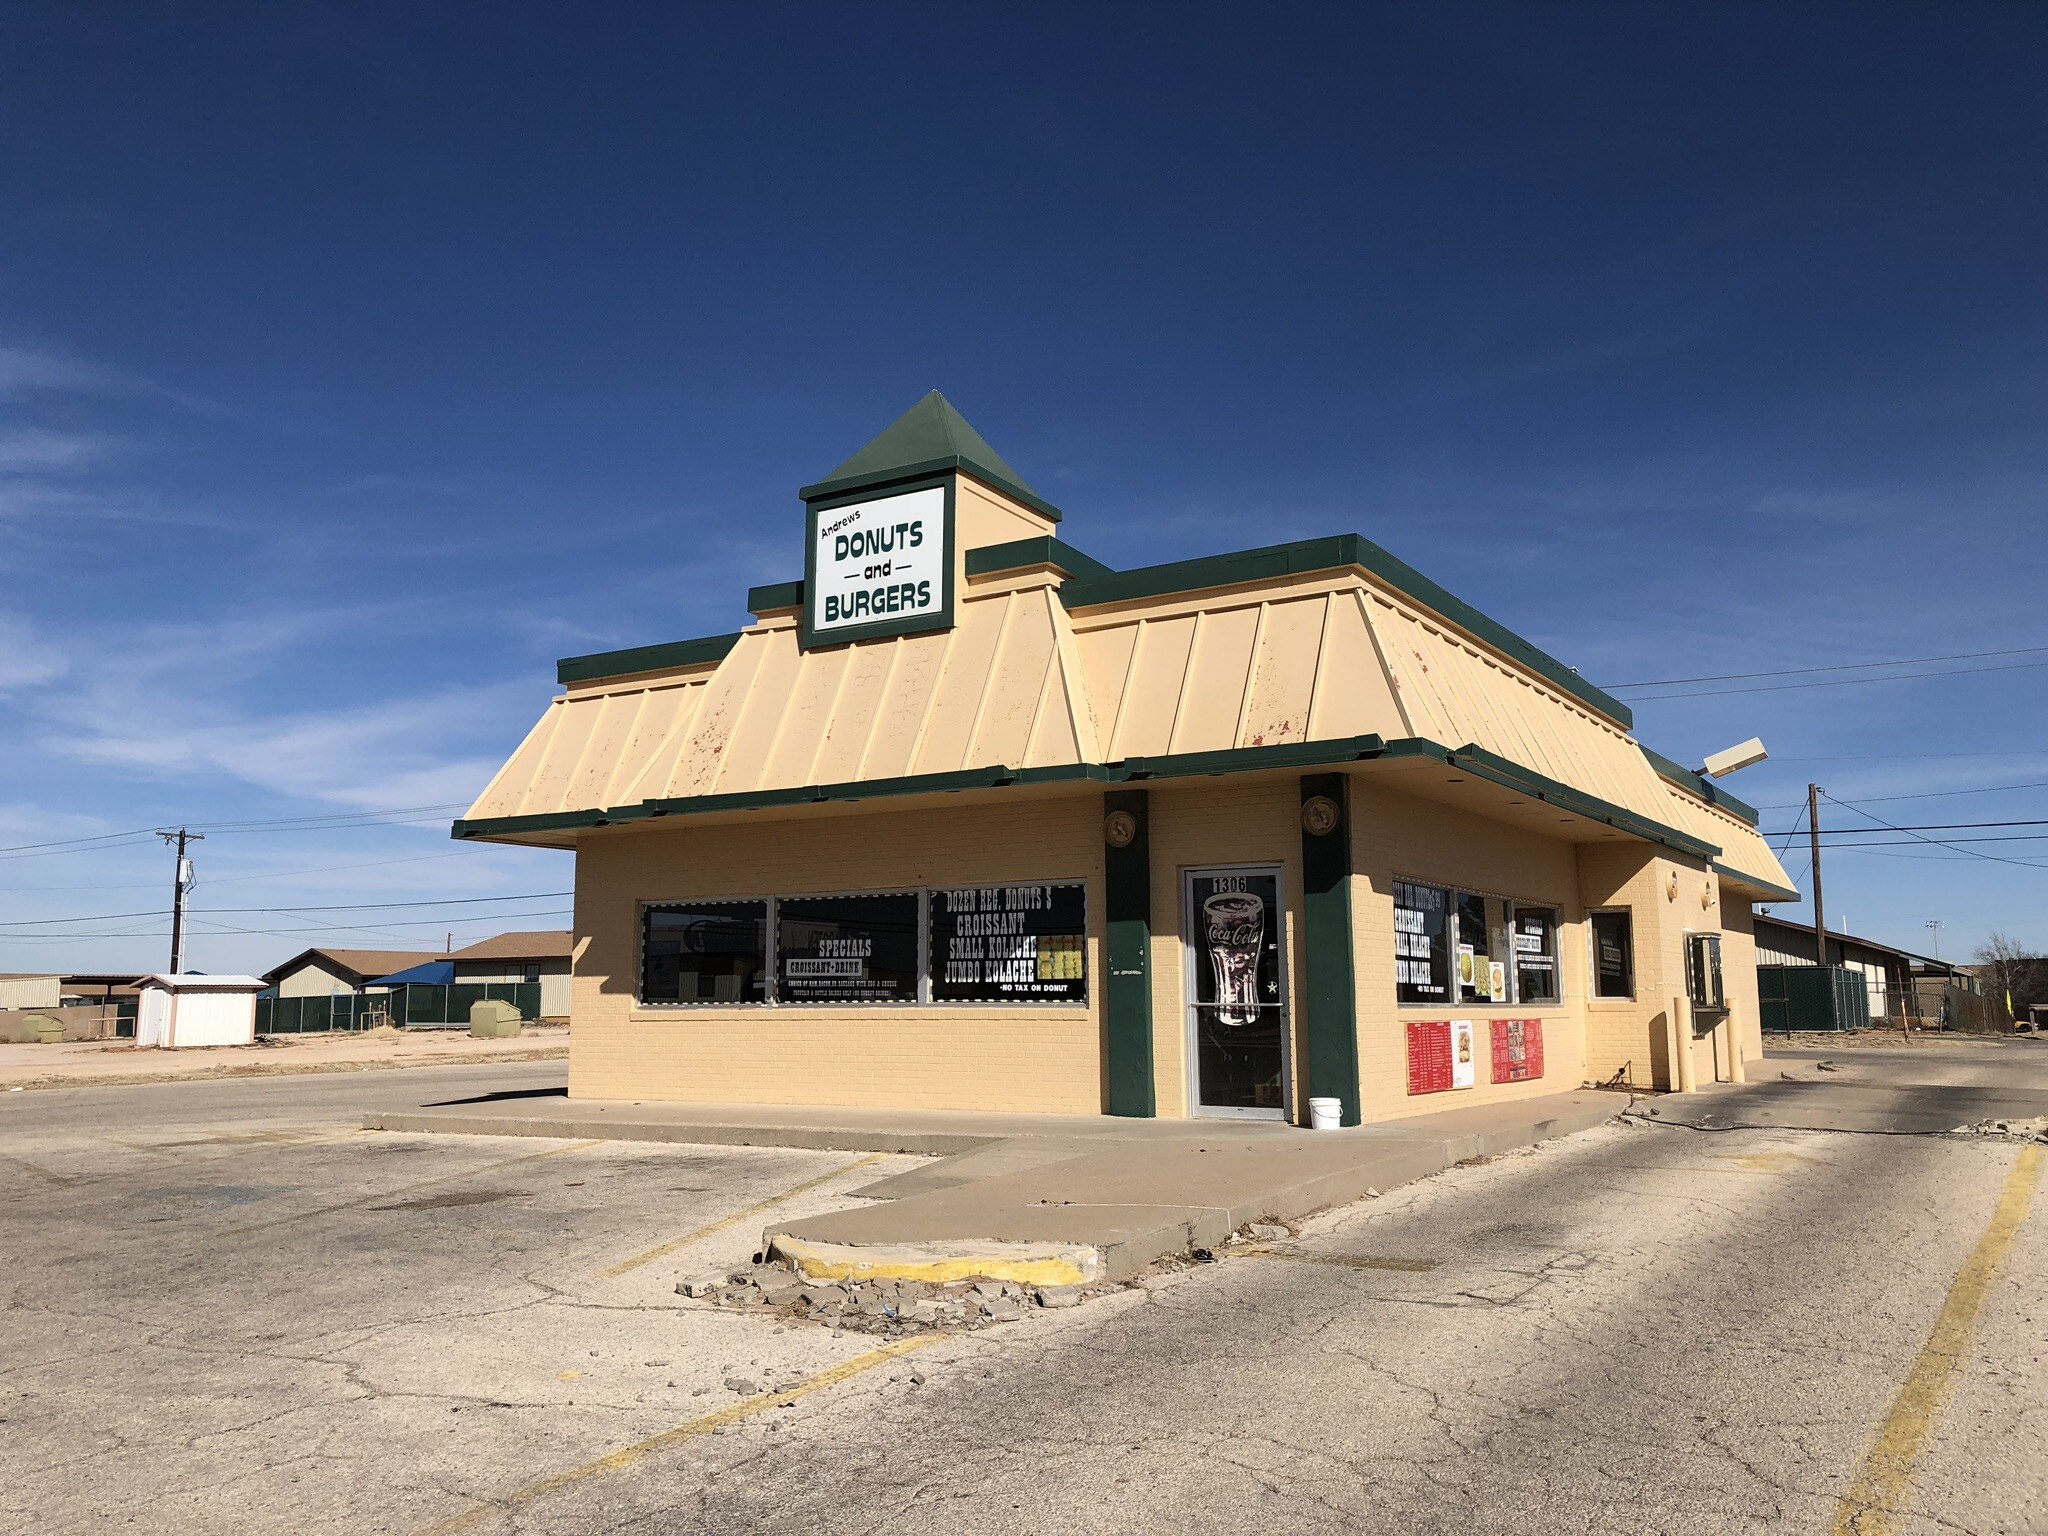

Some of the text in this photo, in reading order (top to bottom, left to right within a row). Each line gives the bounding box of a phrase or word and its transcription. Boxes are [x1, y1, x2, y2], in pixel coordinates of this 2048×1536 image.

[821, 510, 861, 539] Andrews
[835, 520, 923, 562] DONUTS
[864, 559, 892, 580] and
[825, 580, 931, 623] BURGERS
[1214, 876, 1246, 893] 1306
[946, 889, 976, 912] DOZEN
[980, 888, 1001, 911] REG.
[1005, 886, 1042, 911] DONUTS
[957, 912, 1025, 937] CROISSANT
[1208, 920, 1261, 946] Coca-Cola
[819, 939, 872, 957] SPECIALS
[950, 936, 1037, 959] SMALL KOLACHE
[945, 960, 1034, 983] JUMBO KOLACHE
[1031, 984, 1041, 992] ON
[1043, 984, 1068, 992] DONUT
